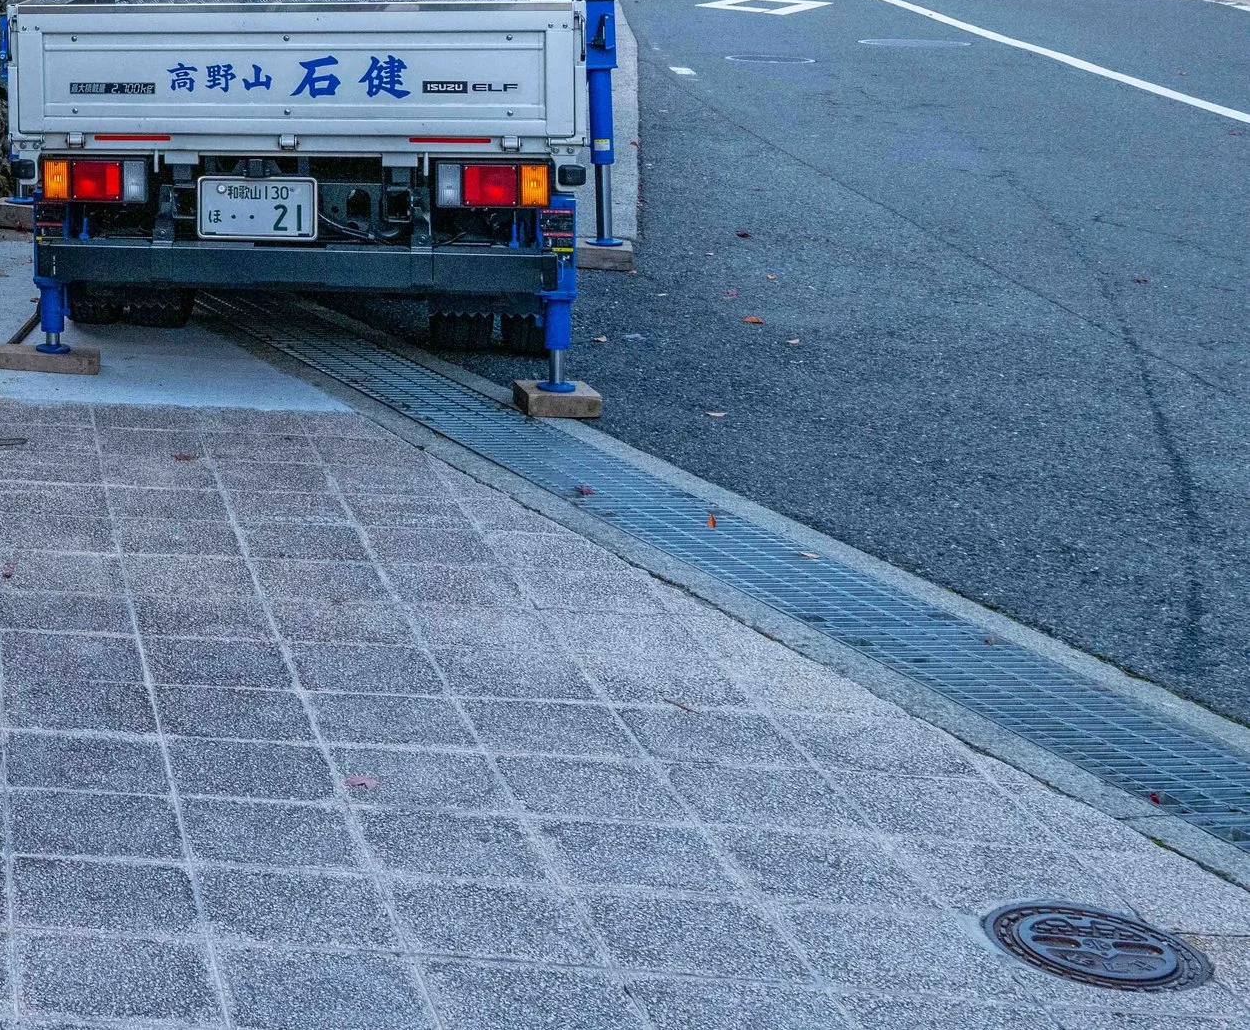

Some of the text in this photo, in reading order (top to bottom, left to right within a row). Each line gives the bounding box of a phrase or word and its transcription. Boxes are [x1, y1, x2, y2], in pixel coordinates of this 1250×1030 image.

[166, 54, 411, 99] 高野山 石健
[426, 83, 519, 92] ISUZU ELF
